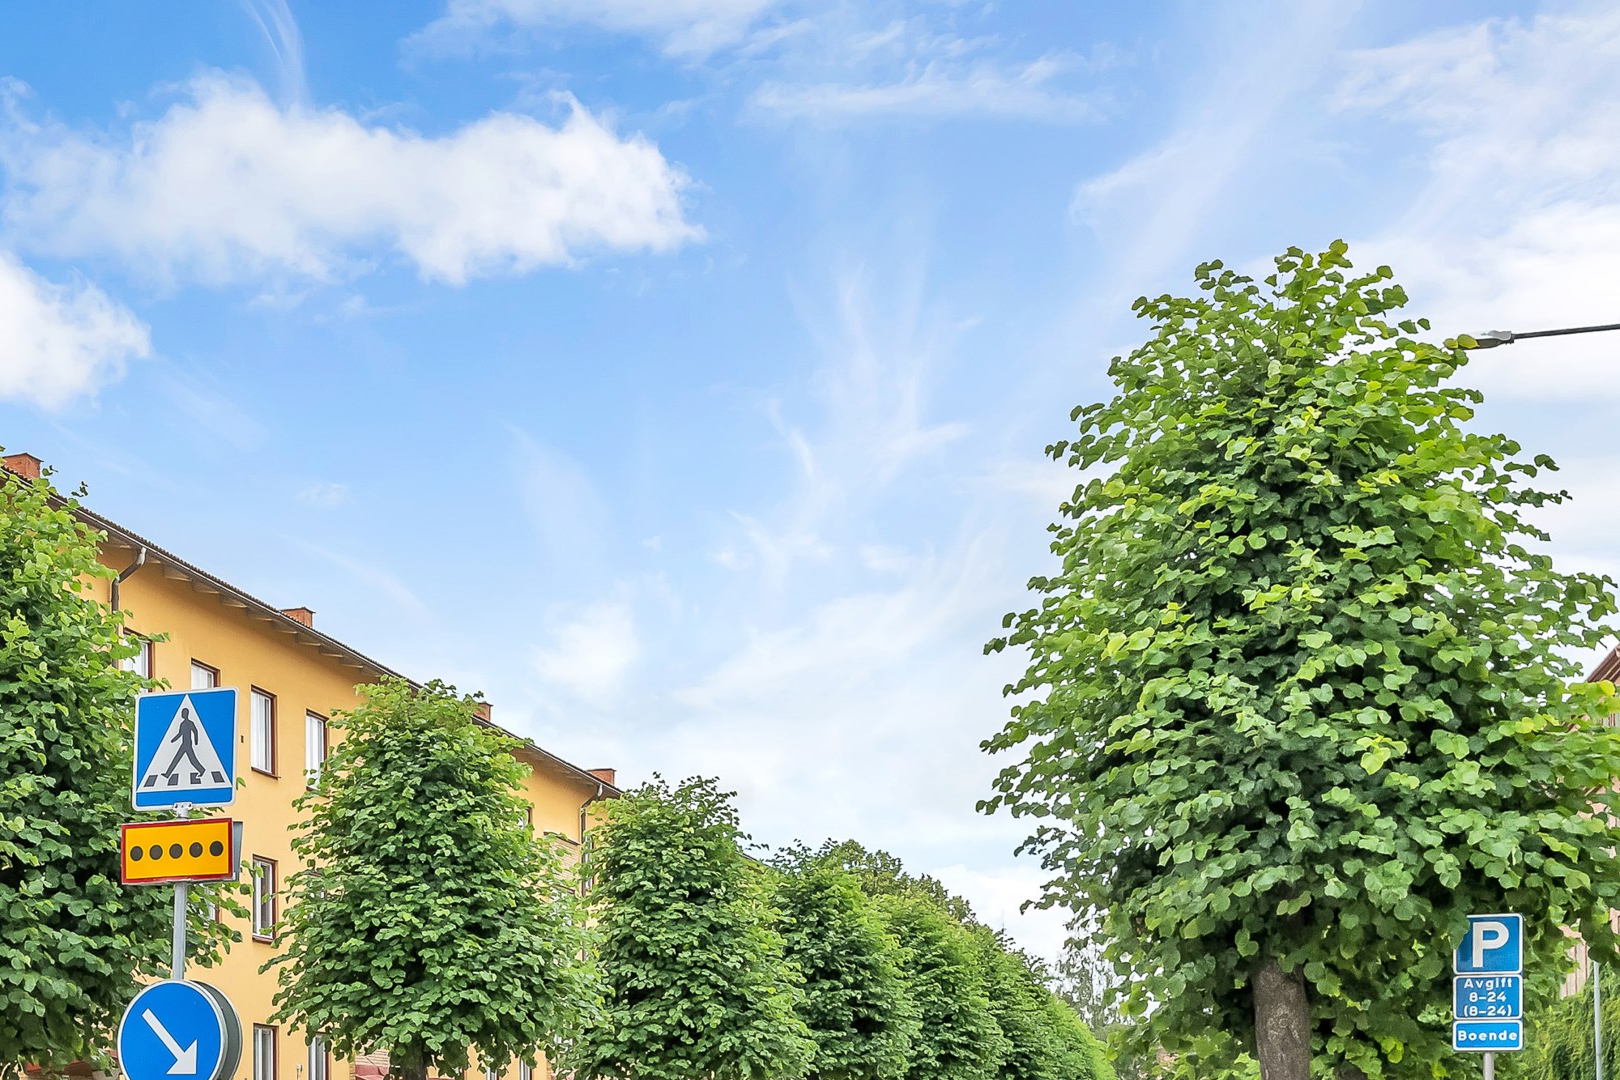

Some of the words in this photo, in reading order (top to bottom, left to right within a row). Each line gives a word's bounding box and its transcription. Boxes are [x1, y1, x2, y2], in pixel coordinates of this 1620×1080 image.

[1472, 921, 1509, 968] P
[1463, 977, 1512, 990] Avgift
[1469, 991, 1506, 1002] 8-24
[1463, 1004, 1512, 1017] (8-24)
[1457, 1030, 1518, 1041] Boende
